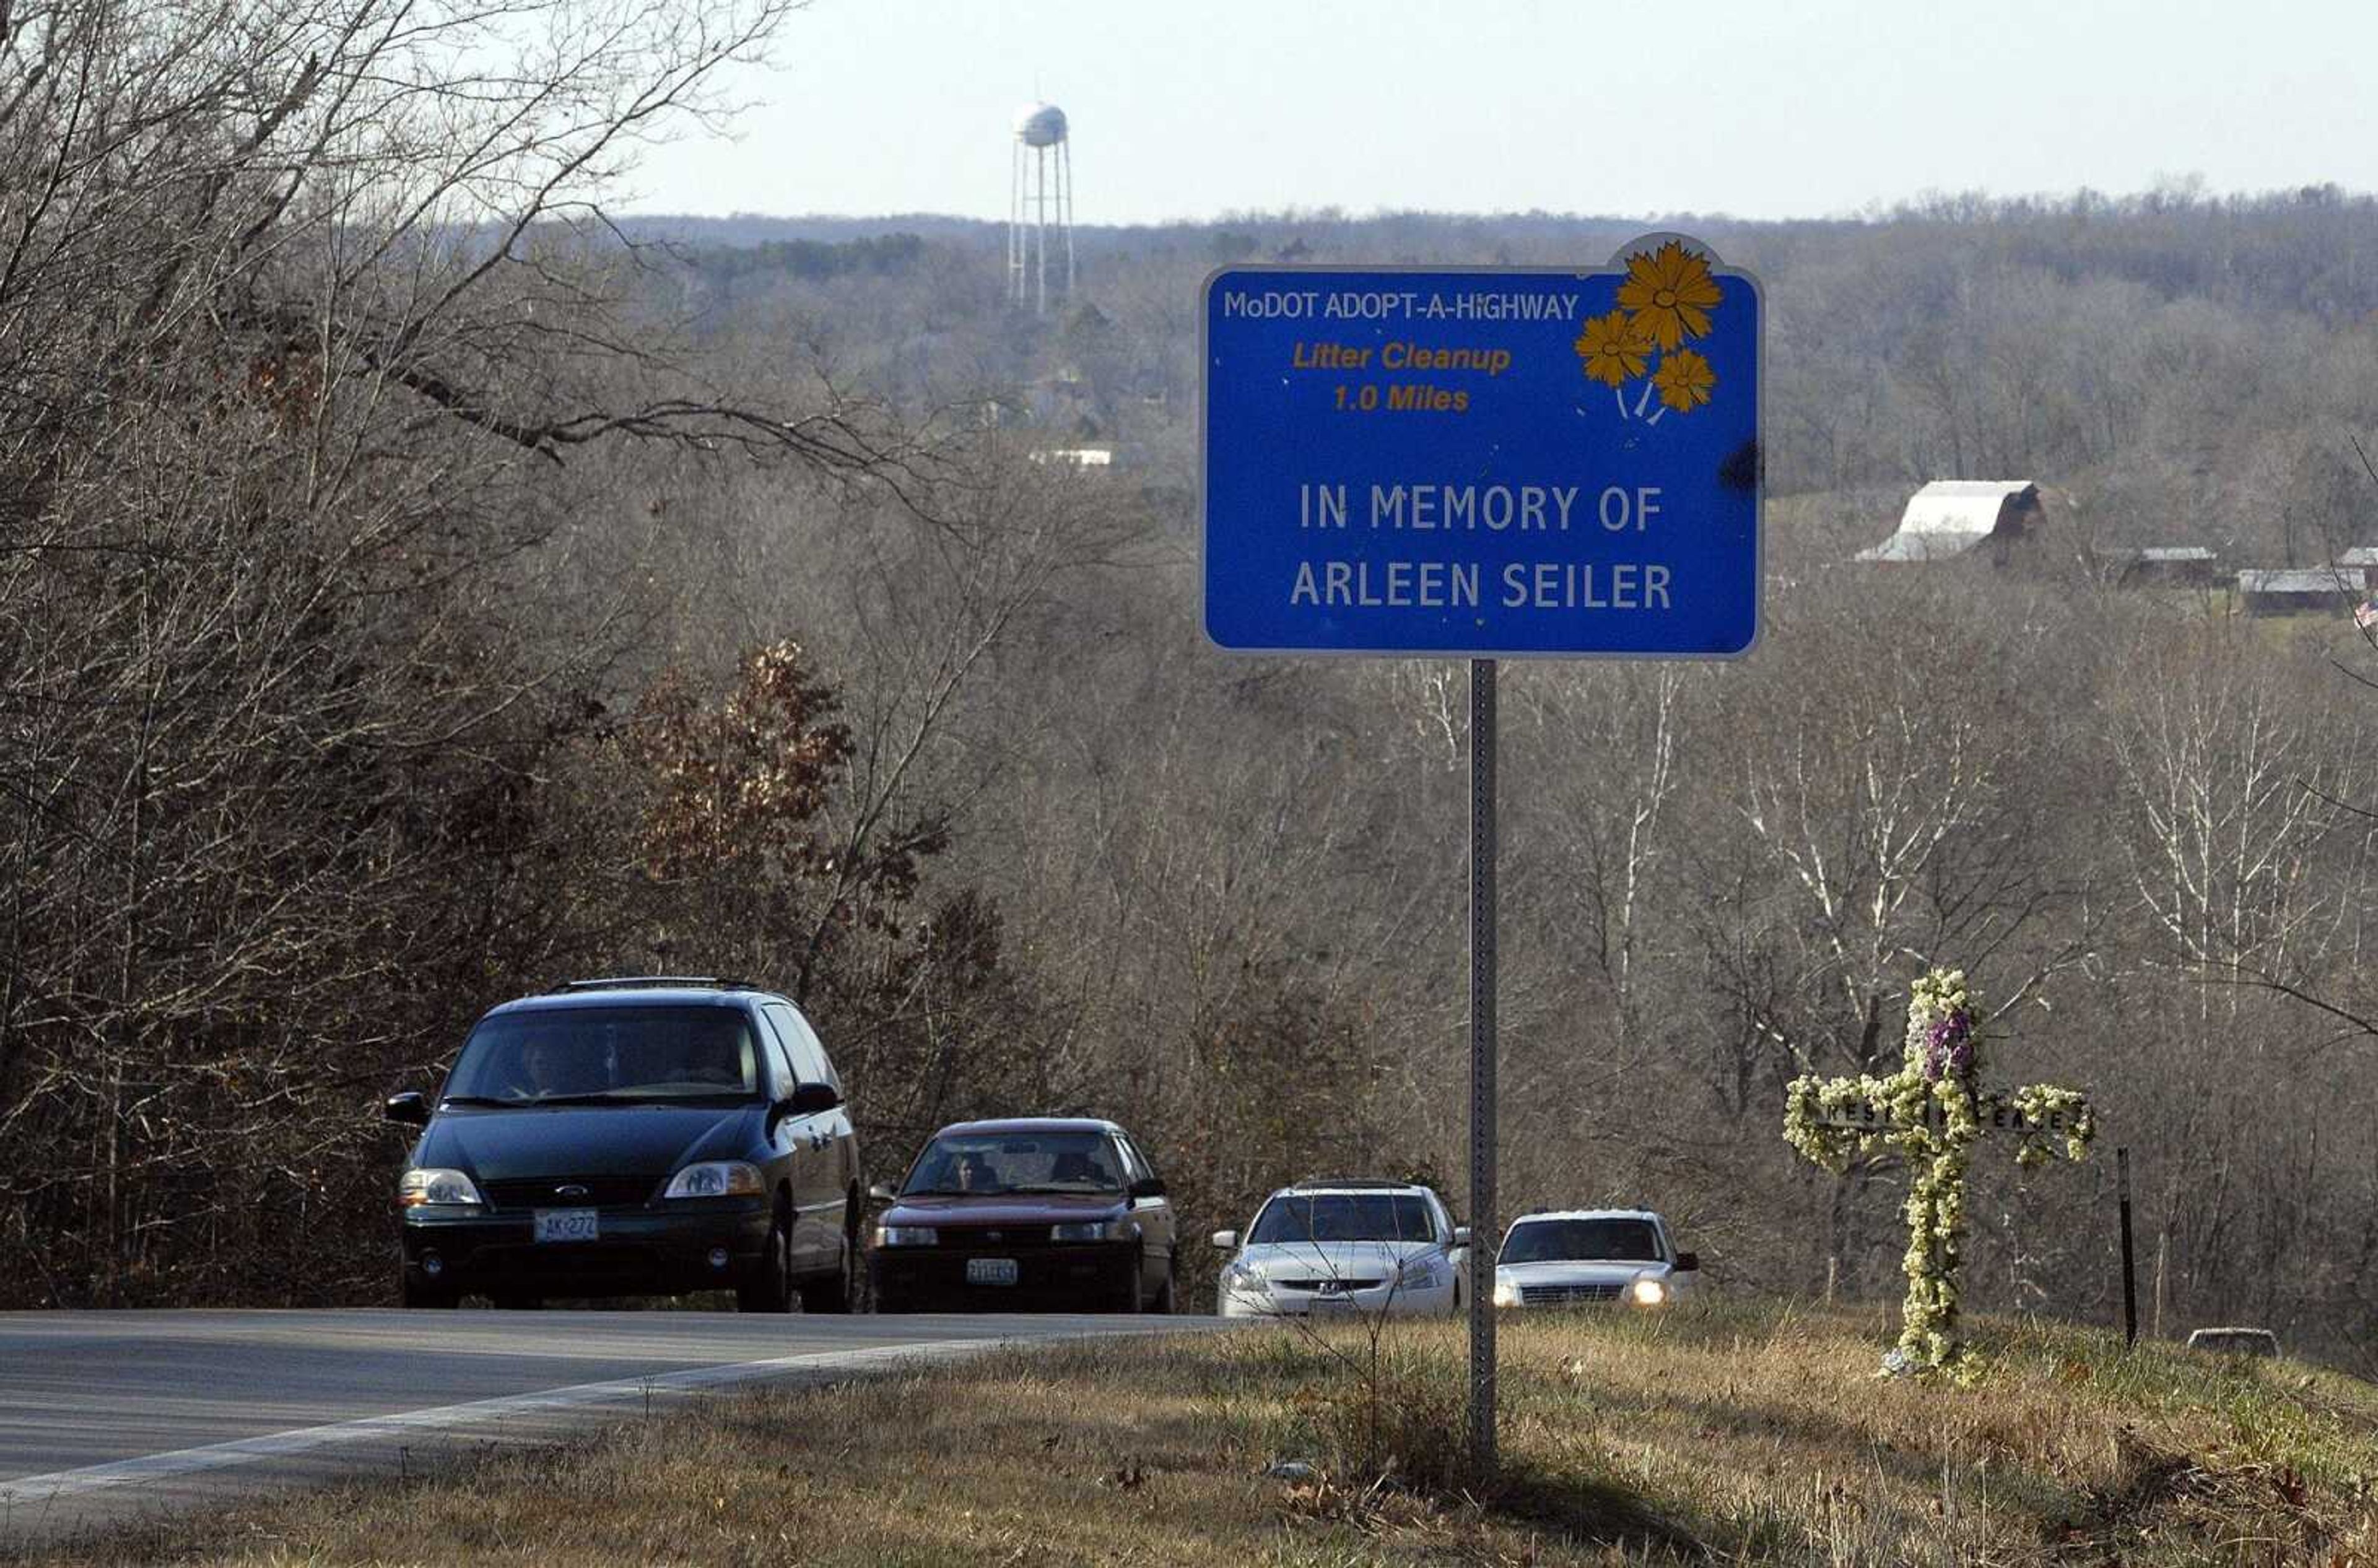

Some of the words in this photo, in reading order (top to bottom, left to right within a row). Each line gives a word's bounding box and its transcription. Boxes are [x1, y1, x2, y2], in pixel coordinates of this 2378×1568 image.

[1224, 292, 1319, 318] MoDOT
[1324, 292, 1579, 320] ADOPT-A-HIGHWAY
[1293, 342, 1372, 368] Litter
[1382, 342, 1511, 375] Cleanup
[1334, 385, 1378, 411] 1.0
[1387, 385, 1470, 411] Miles
[1301, 484, 1346, 528] IN
[1371, 484, 1578, 530] MEMORY
[1600, 487, 1662, 531] OF
[1291, 561, 1478, 606] ARLEEN
[1503, 563, 1670, 609] SEILER
